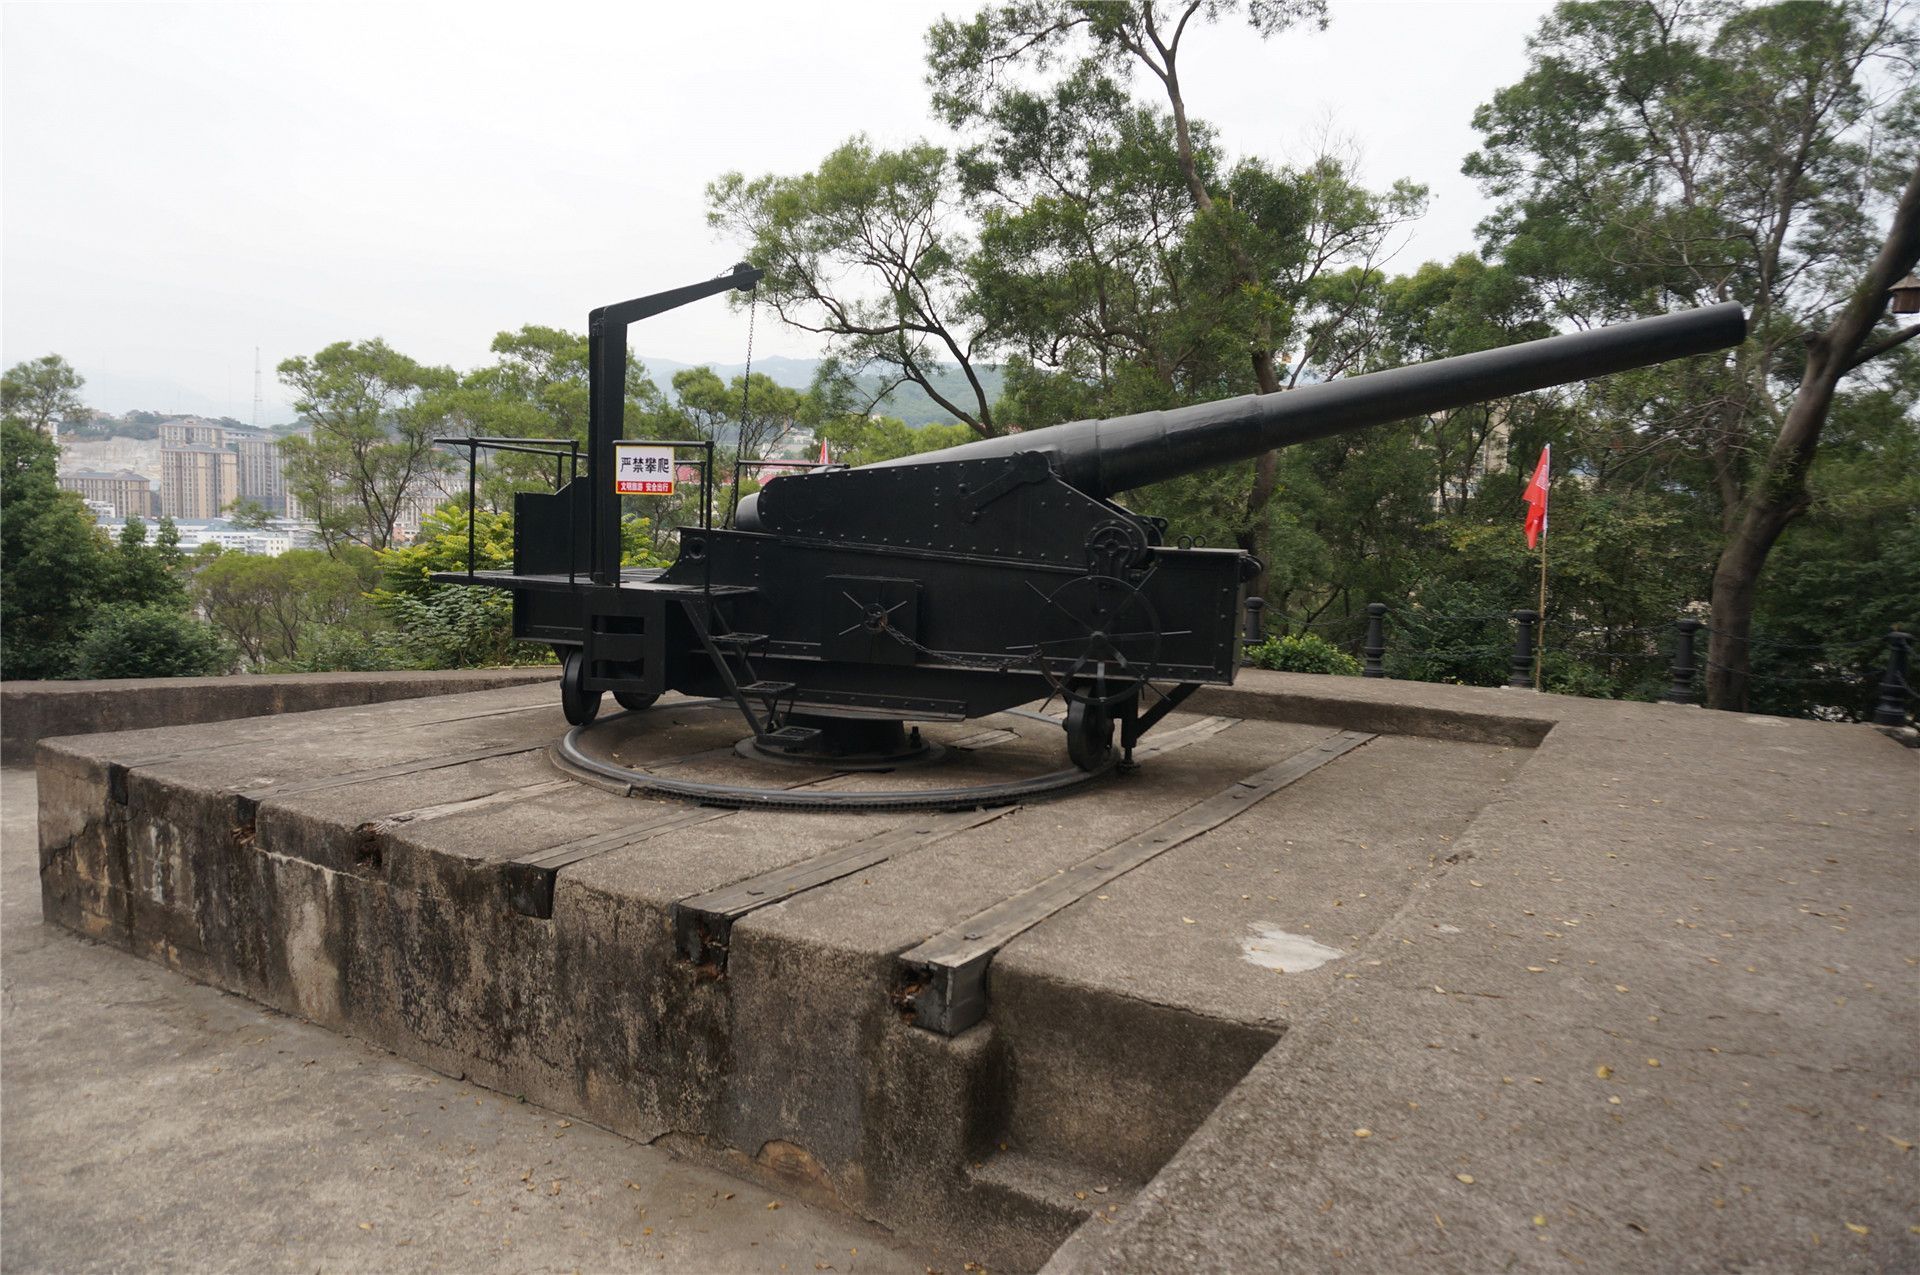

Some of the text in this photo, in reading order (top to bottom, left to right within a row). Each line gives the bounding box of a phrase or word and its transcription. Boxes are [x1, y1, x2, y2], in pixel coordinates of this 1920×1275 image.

[620, 457, 669, 473] 严禁攀爬
[645, 483, 669, 492] 安全出行
